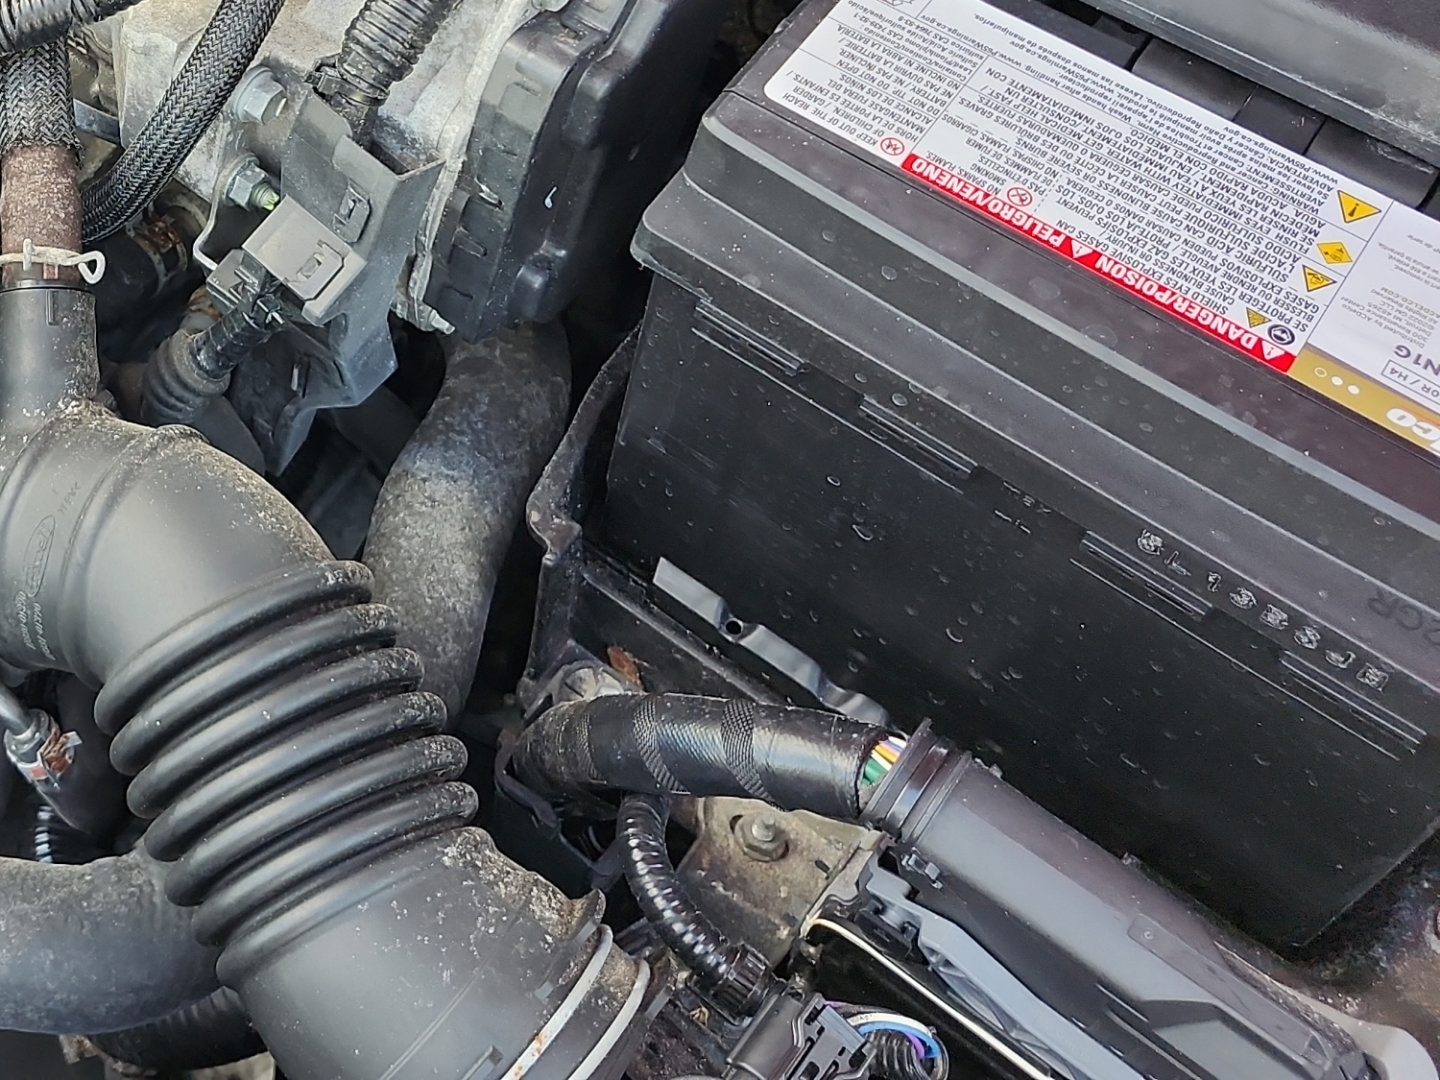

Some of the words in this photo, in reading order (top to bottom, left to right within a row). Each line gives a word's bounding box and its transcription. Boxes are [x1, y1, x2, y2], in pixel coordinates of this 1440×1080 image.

[879, 46, 905, 62] ABRA
[834, 57, 860, 74] OPEN
[858, 69, 878, 83] NOT
[874, 66, 894, 80] PAS
[892, 63, 925, 84] OUVRIR
[913, 63, 948, 83] INCLINE
[983, 67, 1008, 83] CON
[791, 84, 826, 106] GARDER
[824, 77, 844, 91] DEL
[841, 86, 870, 104] FUERA
[864, 86, 884, 100] LOS
[780, 91, 811, 111] REACH
[907, 95, 928, 109] NOT
[1006, 78, 1096, 126] INMEDIATAMENTE
[1011, 101, 1039, 119] HELP
[810, 107, 828, 120] THE
[893, 101, 934, 125] ALCANCE
[837, 121, 858, 135] OUT
[893, 125, 919, 142] HORS
[939, 113, 980, 137] CIGARROS
[1013, 114, 1081, 153] QUEMADURAS
[1038, 114, 1084, 141] MEDICAL
[1093, 121, 1124, 140] OJOS
[854, 130, 879, 146] KEEP
[963, 136, 993, 155] FUMER
[1038, 138, 1060, 154] DES
[1082, 136, 1105, 151] GET
[1121, 134, 1144, 150] LOS
[1045, 153, 1083, 177] SEVERE
[1086, 150, 1132, 179] CEGUERA
[1143, 145, 1193, 174] ENJUAGE
[1182, 154, 1209, 172] CON
[968, 162, 1007, 186] SMOKING
[1129, 172, 1172, 198] CAUSAR
[1141, 165, 1173, 185] WITH
[1167, 167, 1200, 188] L'EAU
[1206, 166, 1250, 192] RAPIDO
[1026, 180, 1047, 195] PAS
[1053, 183, 1076, 200] LOS
[1094, 178, 1152, 212] BLINDNESS
[1117, 177, 1159, 204] CAUSER
[1208, 187, 1238, 207] YEUX
[1248, 186, 1288, 211] ACUDA
[907, 156, 1068, 248] PELIGRO/VENENO
[1053, 195, 1096, 222] PEUVENT
[1156, 197, 1184, 216] PEUT
[1169, 192, 1204, 215] PUEDE
[1170, 180, 1244, 221] IMMEDIATELY
[1237, 202, 1260, 217] LES
[1053, 218, 1077, 235] CAN
[1103, 209, 1126, 226] LOS
[1148, 205, 1184, 229] CAUSE
[1242, 215, 1272, 235] EYES
[1257, 212, 1300, 238] RINSER
[1074, 229, 1111, 253] GASES
[1093, 216, 1149, 250] EXPLOSIFS
[1124, 219, 1172, 249] PROTEJA
[1142, 218, 1183, 243] CAUSAR
[1181, 209, 1252, 251] SULFURIQUE
[1181, 222, 1207, 240] CAN
[1146, 243, 1171, 261] GAZ
[1179, 236, 1219, 262] PUEDEN
[1204, 233, 1235, 255] ACID
[1273, 230, 1311, 254] FLUSH
[1108, 247, 1165, 281] EXPLOSIVE
[1168, 254, 1191, 271] LES
[1233, 248, 1291, 283] SULFURIC
[1249, 244, 1297, 273] L'ACIDE
[1151, 257, 1205, 289] BLINDNESS
[1187, 264, 1219, 286] YEUX
[1217, 256, 1285, 296] EXPLOSIVOS
[1219, 268, 1259, 294] RENDRE
[1162, 275, 1192, 295] EYES
[1203, 284, 1236, 306] CAUSE
[1216, 279, 1239, 296] LES
[1093, 254, 1260, 350] DANGER/POISON
[1189, 289, 1230, 315] SHIELD
[1271, 295, 1316, 323] BLESSER
[1281, 288, 1322, 315] GASES
[1340, 302, 1373, 322] ACDelco
[1387, 366, 1408, 381] H4
